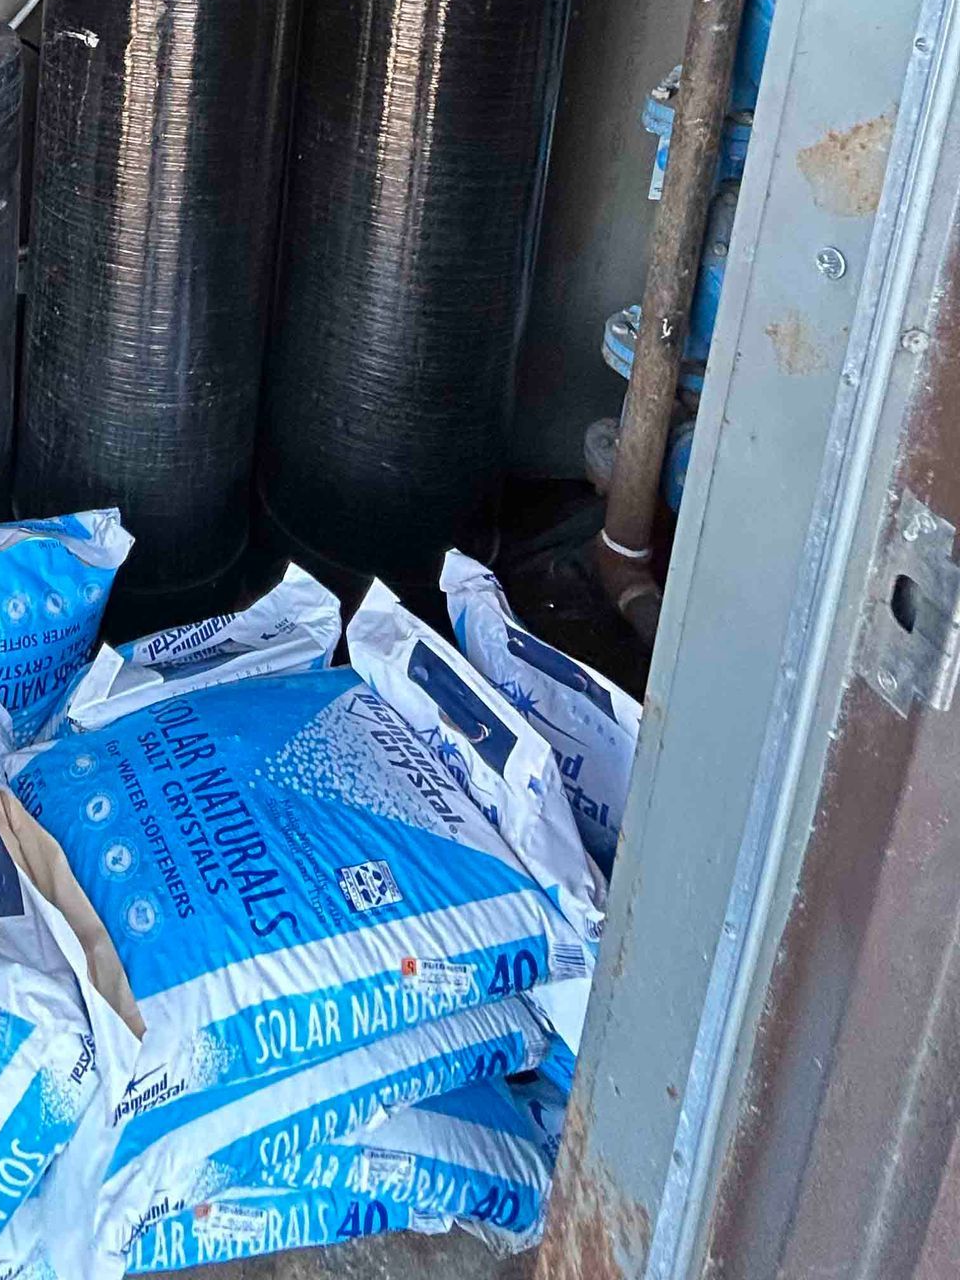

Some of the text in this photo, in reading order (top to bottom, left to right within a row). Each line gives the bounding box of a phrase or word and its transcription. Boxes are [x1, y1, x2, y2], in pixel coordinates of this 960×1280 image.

[43, 624, 81, 644] WATER
[353, 692, 458, 793] Diamond
[104, 739, 196, 920] for WATER SOFTENERS
[136, 730, 230, 896] SALT CRYSTALS
[148, 698, 217, 769] SOLAR
[185, 766, 301, 938] NATURALS
[254, 999, 342, 1065] SOLAR
[351, 977, 480, 1039] NATURALS
[487, 949, 540, 997] 40
[259, 1107, 339, 1175] SOLAR
[336, 1199, 390, 1239] 40
[471, 1184, 522, 1227] 40
